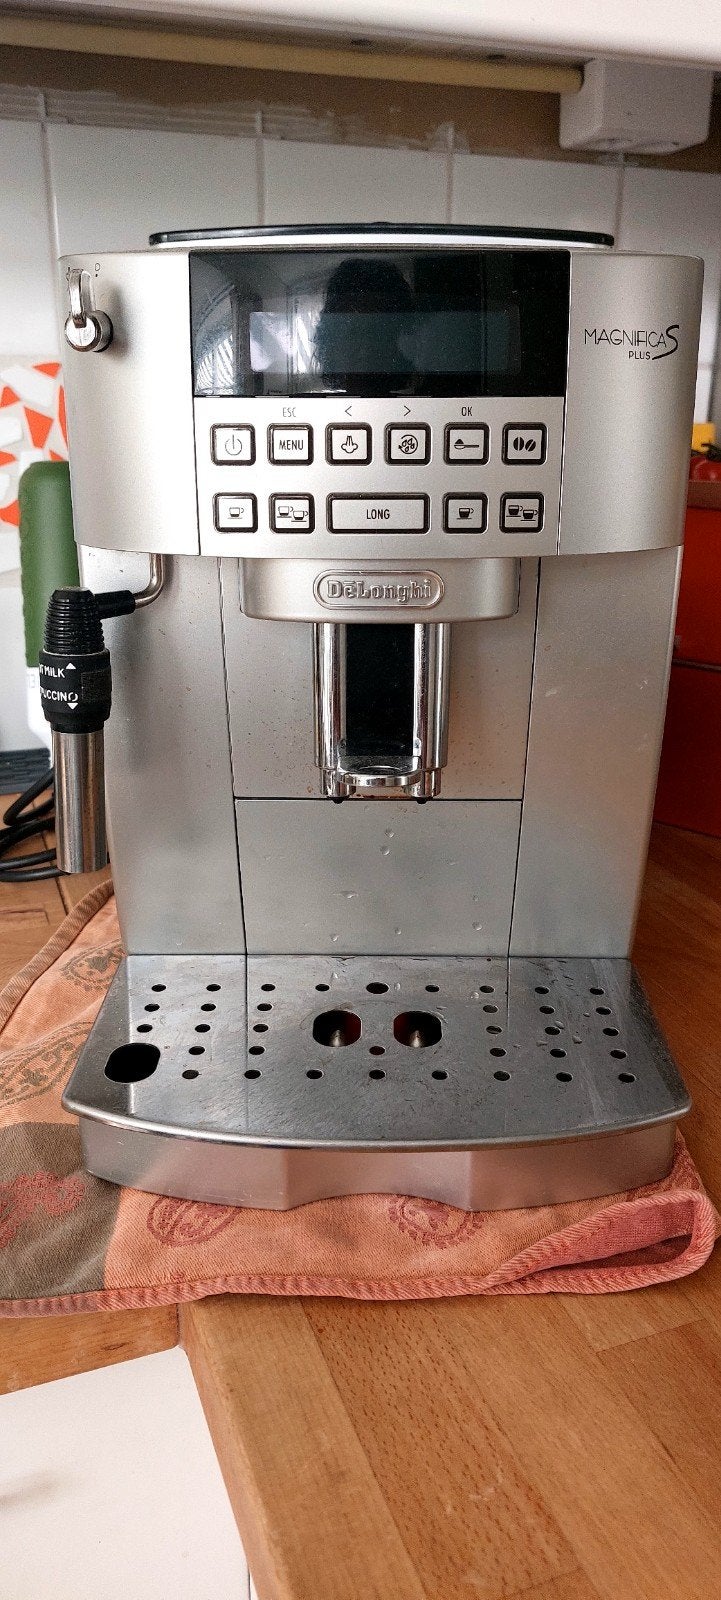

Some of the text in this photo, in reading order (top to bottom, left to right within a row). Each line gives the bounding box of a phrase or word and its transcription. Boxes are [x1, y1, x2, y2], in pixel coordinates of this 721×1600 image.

[584, 328, 667, 348] MAGNIFICA
[628, 350, 651, 360] PLUS
[282, 406, 297, 418] ESC
[461, 406, 473, 417] OK
[279, 439, 304, 451] MENU
[366, 508, 391, 520] LONG
[44, 665, 66, 678] MILK
